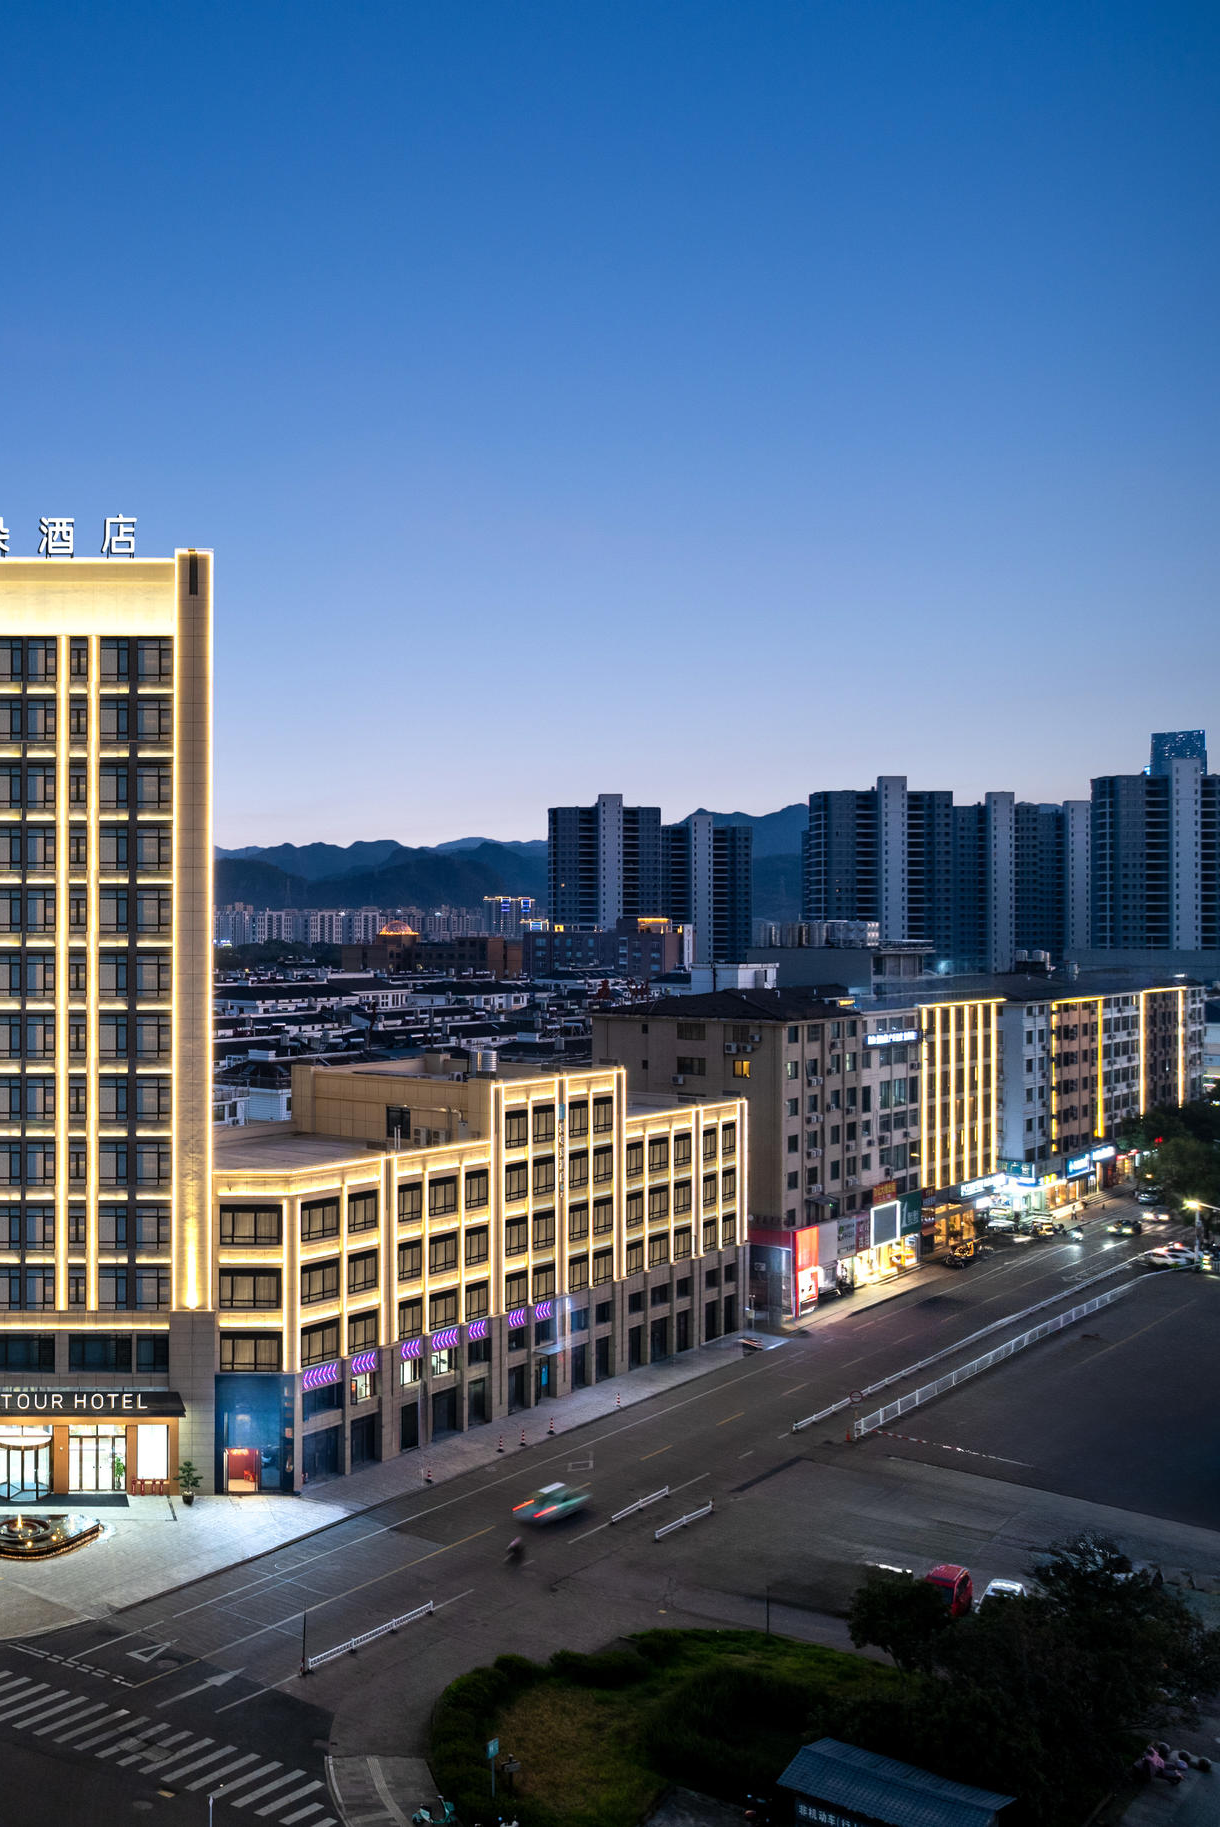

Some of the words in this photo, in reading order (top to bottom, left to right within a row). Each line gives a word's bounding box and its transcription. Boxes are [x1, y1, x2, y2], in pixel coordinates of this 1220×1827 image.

[74, 1393, 149, 1410] HOTEL
[798, 1804, 859, 1827] 非机动车(行
